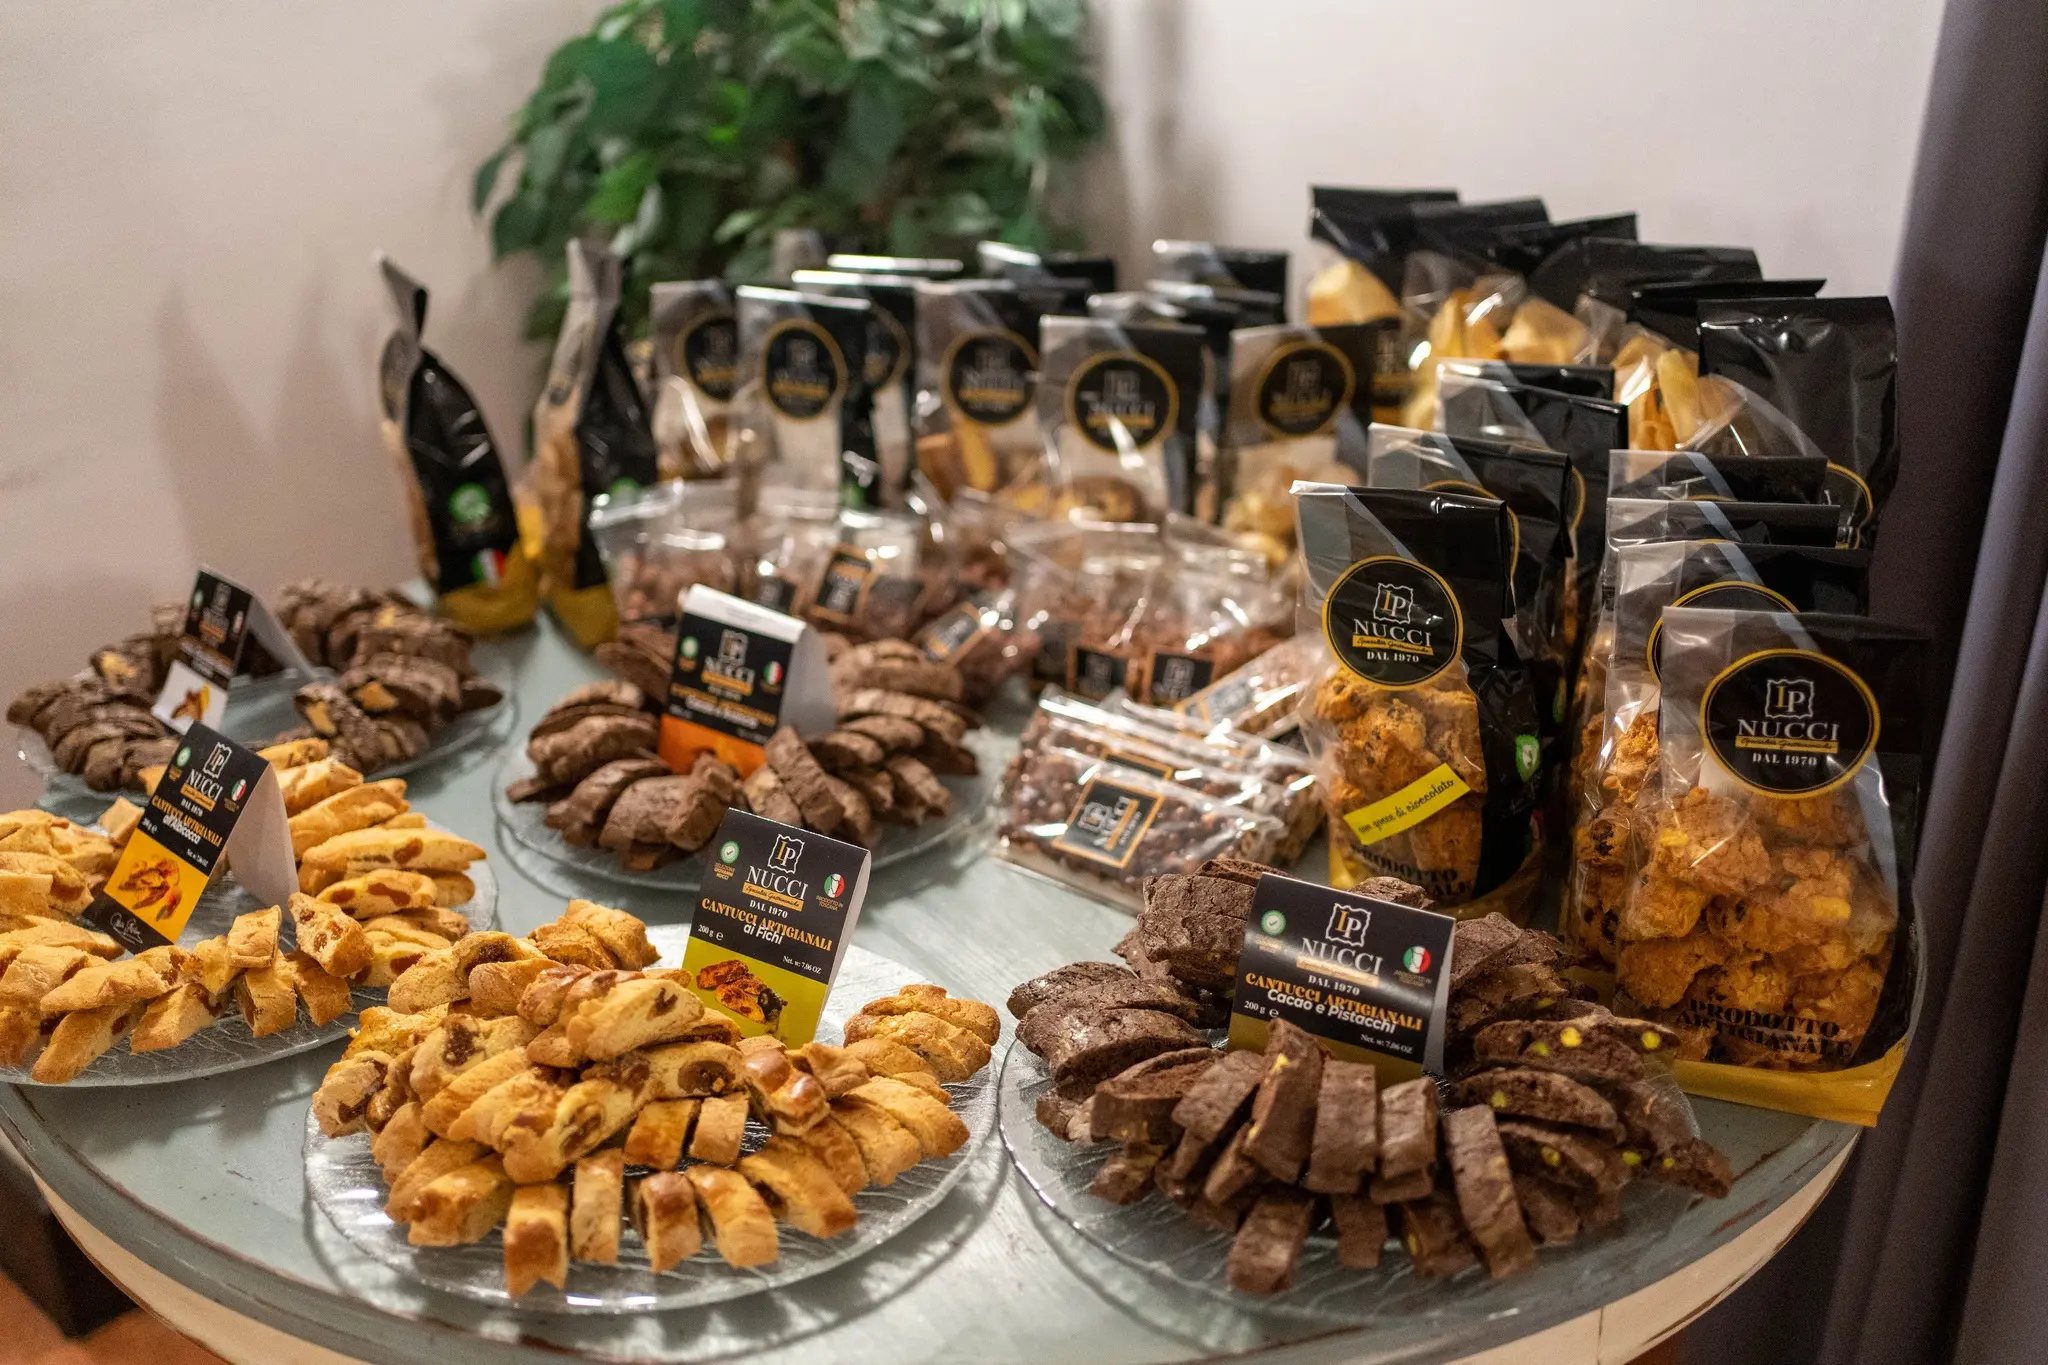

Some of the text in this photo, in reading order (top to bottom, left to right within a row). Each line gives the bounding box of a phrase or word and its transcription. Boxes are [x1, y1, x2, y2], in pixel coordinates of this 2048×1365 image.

[1353, 619, 1432, 647] NUCCI
[1366, 651, 1420, 663] DAL 1970
[1737, 719, 1840, 741] NUCCI
[1752, 752, 1818, 766] DAL 1970
[185, 769, 224, 801] NUCCI
[745, 866, 809, 900] NUCCI
[749, 899, 788, 919] DAL 1970
[698, 924, 710, 935] 200
[702, 897, 833, 952] CANTUCCI ARTIGIANALI
[756, 925, 784, 945] Fichi
[1301, 937, 1384, 976] NUCCI
[812, 965, 822, 975] OZ
[1308, 974, 1361, 997] DAL 1970
[1243, 1000, 1259, 1011] 200
[1259, 1006, 1266, 1014] g
[1245, 972, 1321, 1003] CANTUCCI
[1324, 993, 1423, 1031] ARTIGIANALI
[1267, 988, 1397, 1034] Cacao e Pistacchi
